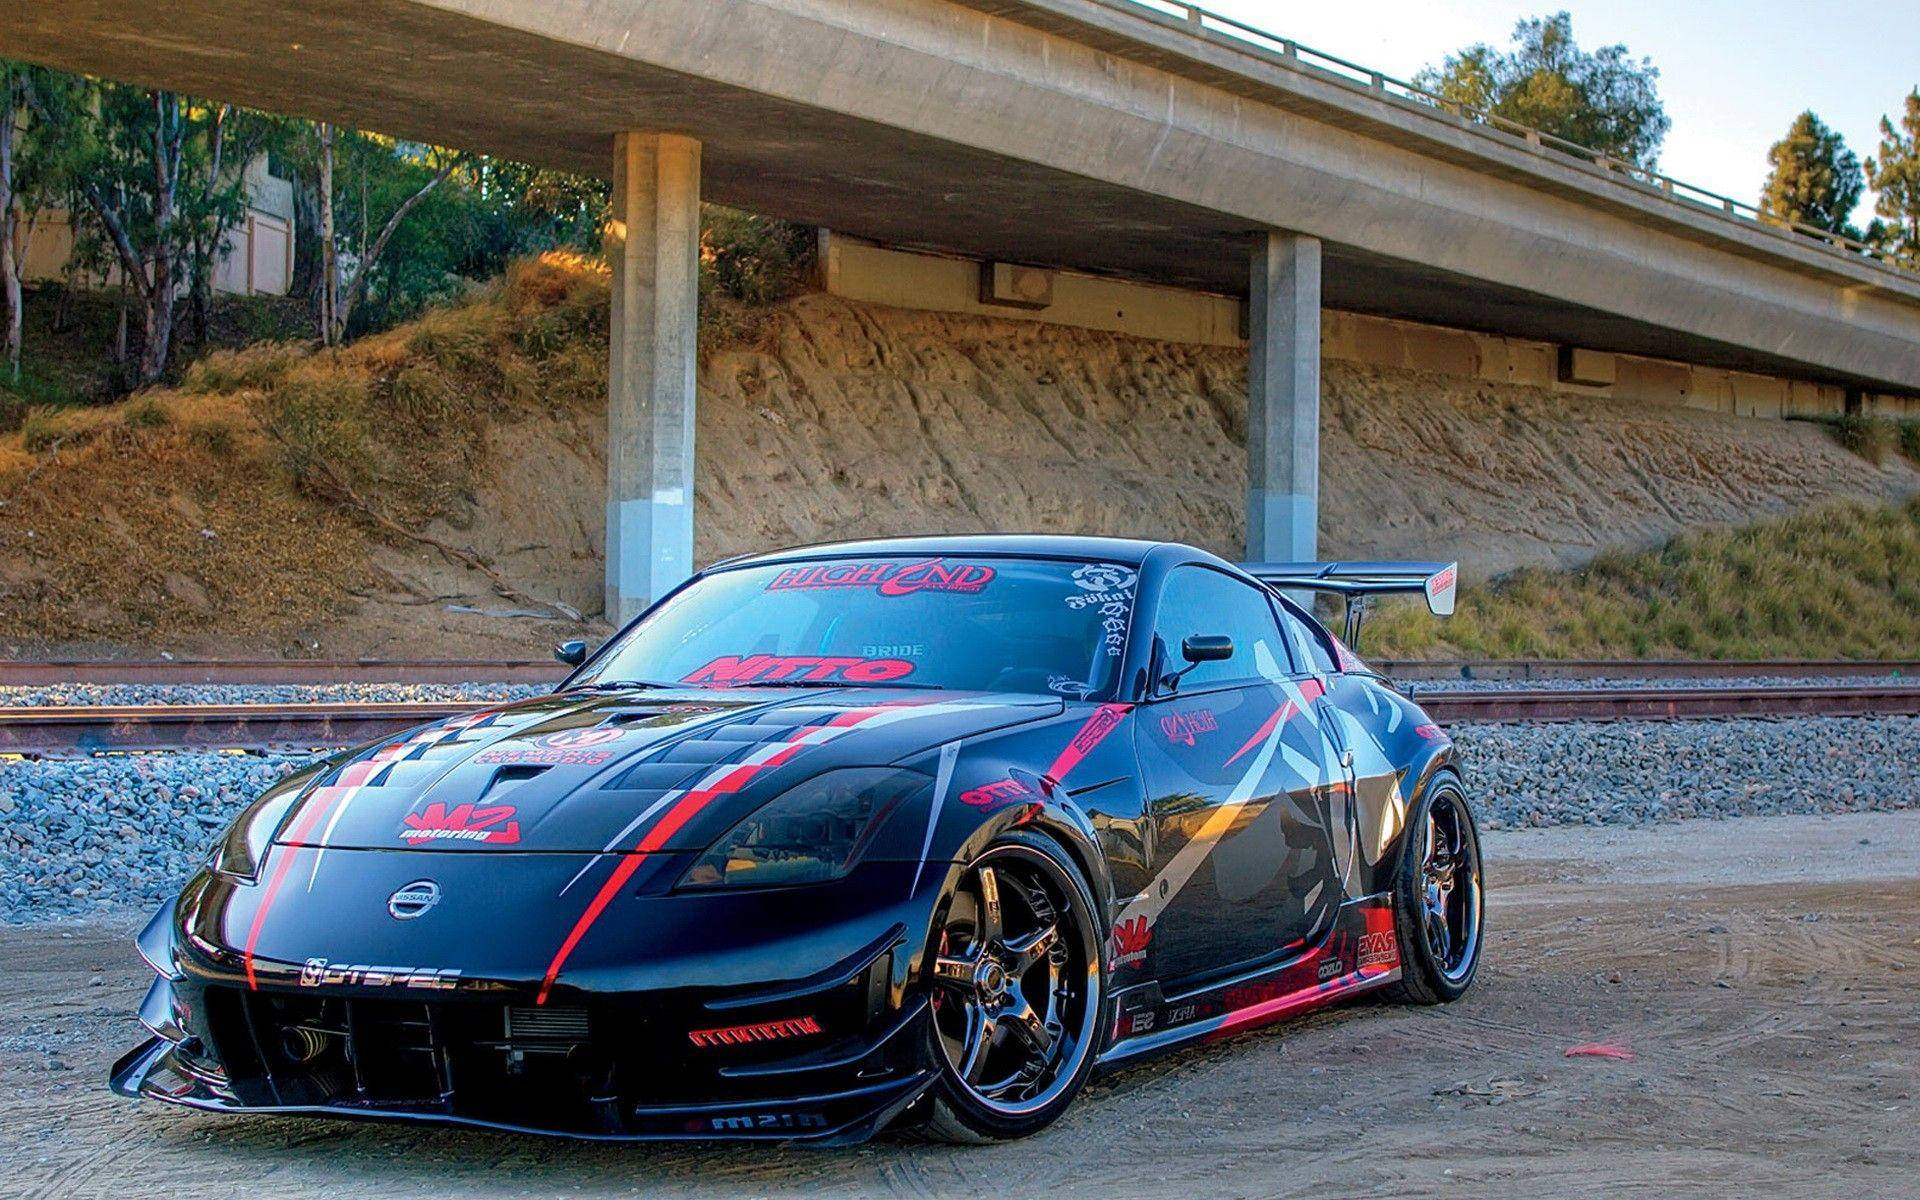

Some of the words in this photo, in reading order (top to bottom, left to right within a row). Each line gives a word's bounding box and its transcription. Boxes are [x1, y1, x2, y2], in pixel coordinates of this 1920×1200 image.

[768, 564, 894, 590] HIGH
[862, 645, 924, 657] BRIDE
[679, 654, 916, 683] NITTO
[402, 802, 522, 845] M2
[398, 829, 491, 841] motoring
[396, 892, 432, 902] NISSAN
